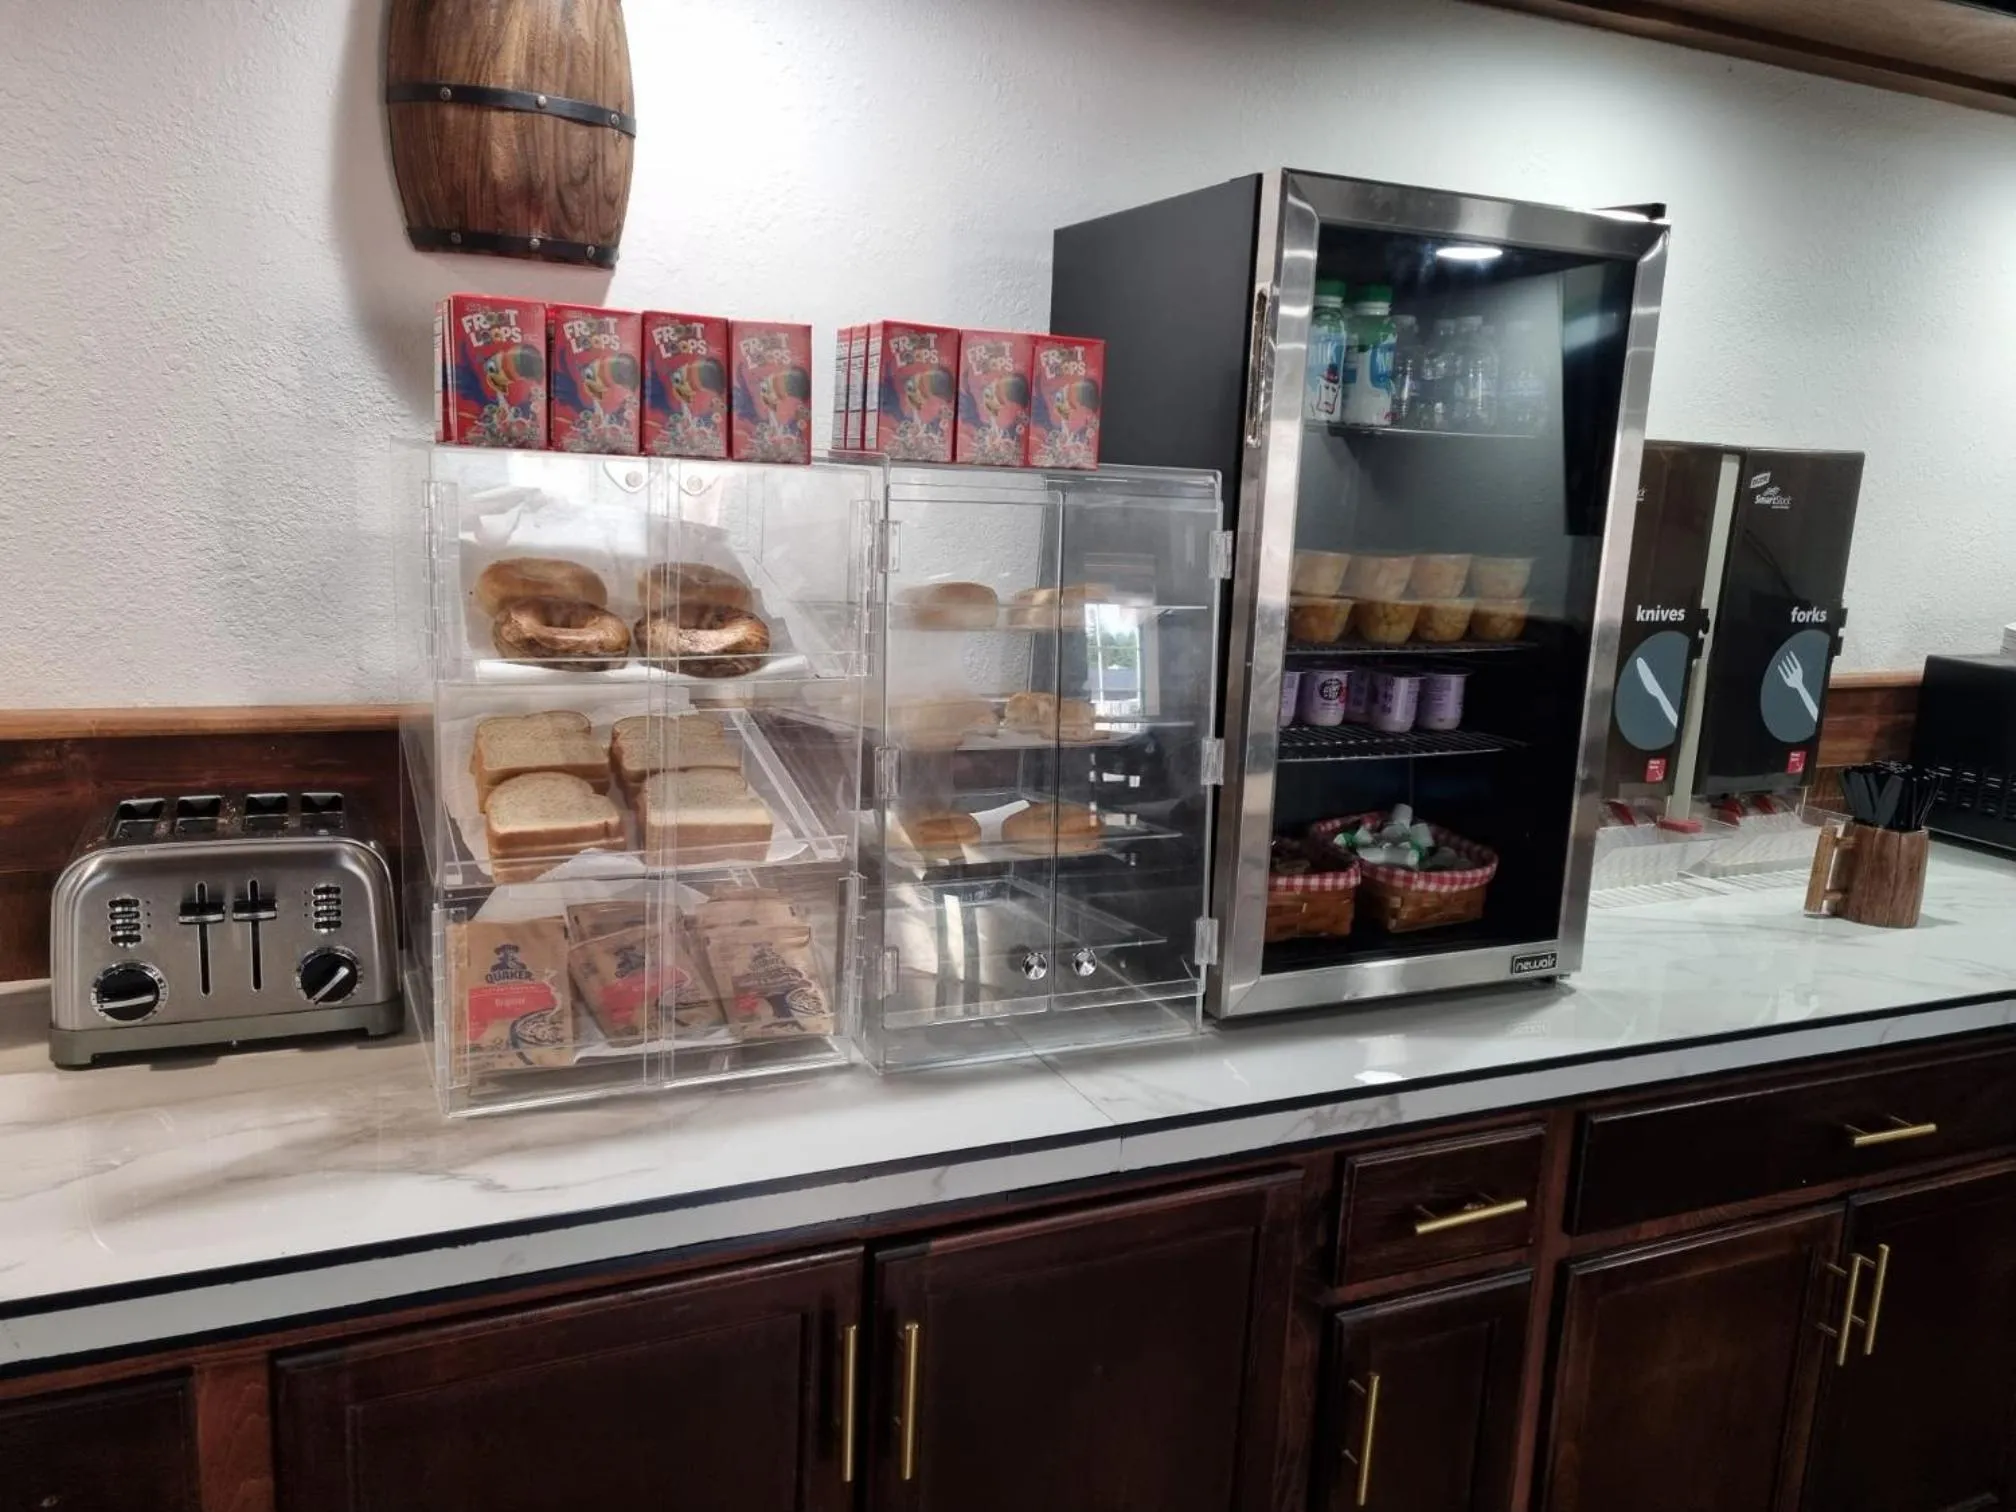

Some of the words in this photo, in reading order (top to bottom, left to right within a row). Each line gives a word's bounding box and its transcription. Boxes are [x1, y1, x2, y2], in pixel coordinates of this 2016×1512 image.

[469, 327, 523, 348] LOOPS
[1636, 605, 1686, 622] knives
[1791, 606, 1827, 624] forks
[485, 969, 536, 985] QUAKER
